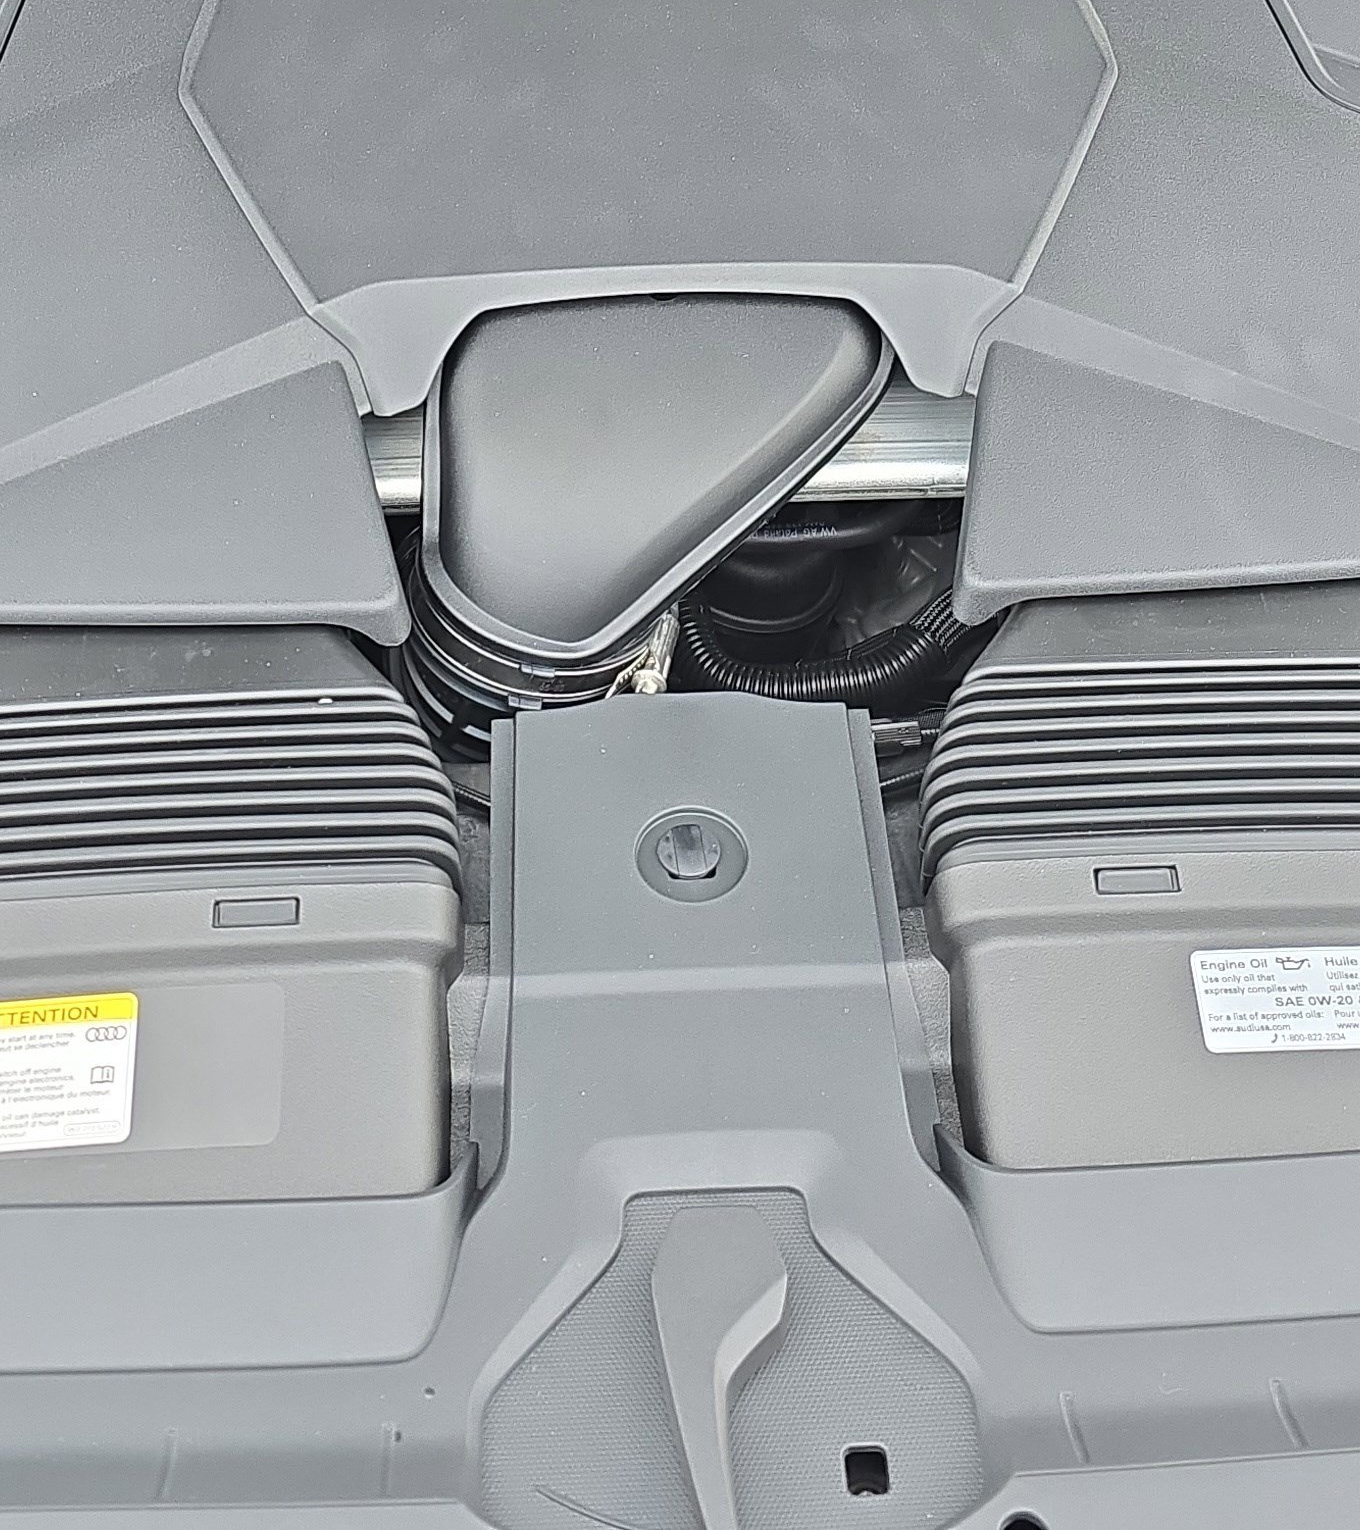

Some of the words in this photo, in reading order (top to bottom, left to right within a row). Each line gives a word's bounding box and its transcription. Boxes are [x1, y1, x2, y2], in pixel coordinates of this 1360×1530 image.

[1200, 960, 1246, 971] Engine
[1250, 958, 1268, 969] Oil
[1324, 957, 1358, 966] Huile
[1201, 975, 1219, 983] Use
[1221, 974, 1241, 983] only
[1244, 974, 1255, 982] oil
[1257, 974, 1275, 982] that
[1327, 970, 1358, 980] Utilisez
[1204, 986, 1245, 995] expressly
[1248, 984, 1287, 994] complies
[1289, 984, 1307, 992] with
[1329, 983, 1344, 992] qui
[1275, 997, 1304, 1007] SAE
[1308, 995, 1353, 1006] 0W-20
[1208, 1013, 1223, 1022] For
[1233, 1012, 1247, 1021] list
[1249, 1011, 1258, 1020] of
[1261, 1011, 1303, 1021] approved
[1334, 1009, 1355, 1018] Pour
[1210, 1024, 1291, 1033] www.audiusa.com
